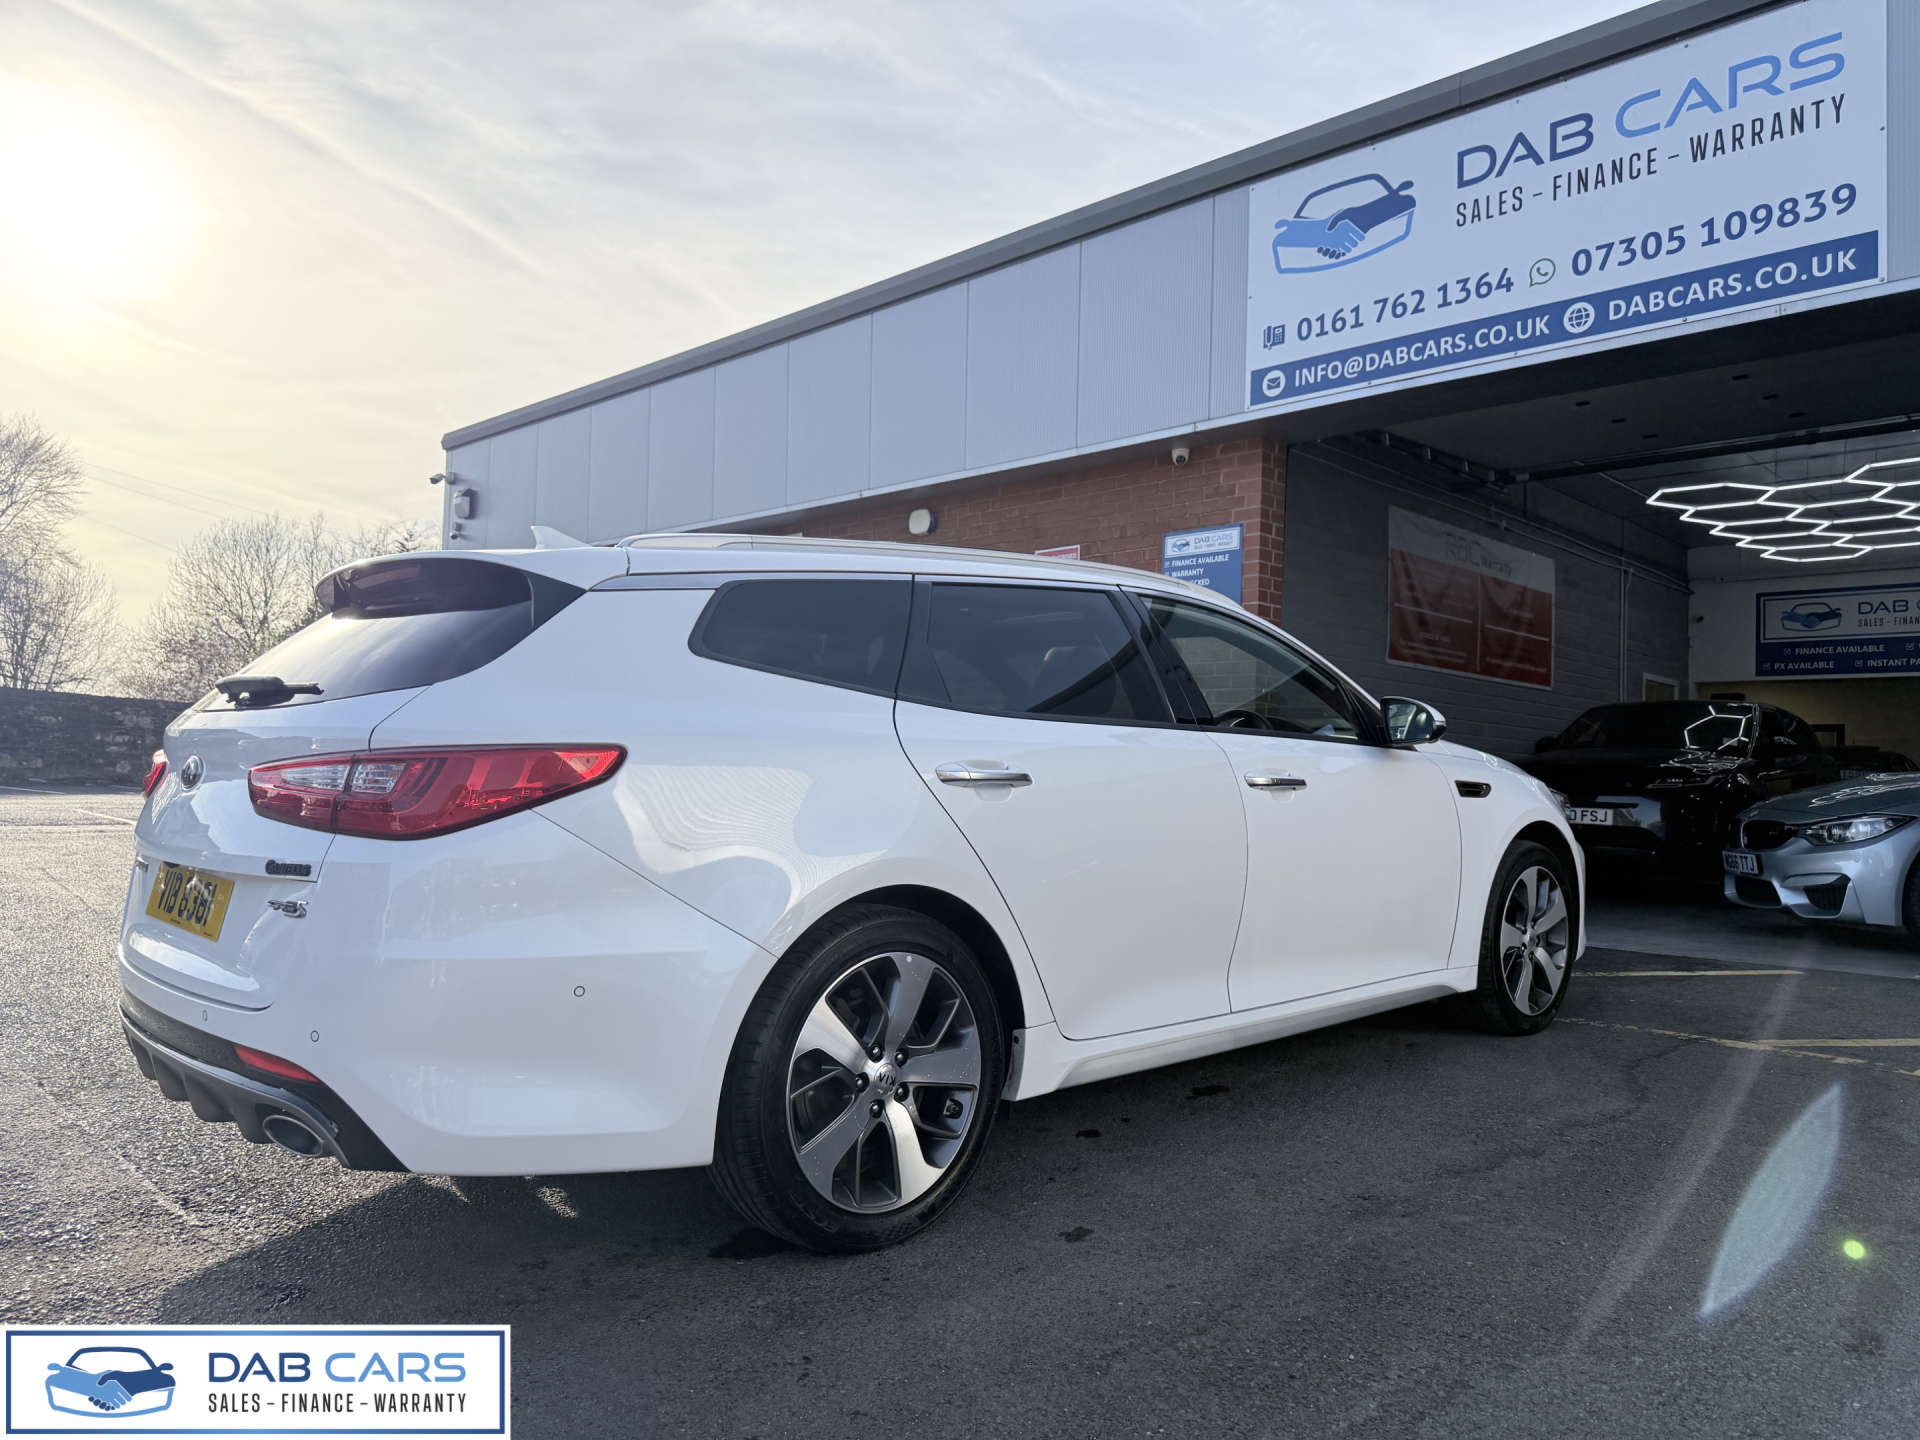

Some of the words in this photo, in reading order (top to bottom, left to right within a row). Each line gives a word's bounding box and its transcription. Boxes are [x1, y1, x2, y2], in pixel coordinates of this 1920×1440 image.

[1456, 112, 1594, 190] DAB
[1615, 31, 1846, 139] CARS
[1456, 186, 1524, 227] SALES
[1552, 147, 1658, 201] FINANCE
[1689, 93, 1846, 163] WARRANTY
[1571, 224, 1687, 277] 07305
[1700, 183, 1857, 247] 109839
[1608, 248, 1857, 321] DABCARS.CO.UK
[1296, 304, 1364, 342] 0161
[1373, 289, 1426, 323] 762
[1436, 267, 1515, 309] 1364
[1294, 314, 1551, 388] INFO@DABCARS.CO.UK
[1172, 558, 1196, 567] FINANCE
[1198, 554, 1229, 563] AVAILABLE
[1172, 568, 1204, 577] WARRANTY
[1858, 599, 1909, 615] DAB
[1857, 617, 1884, 628] SALES
[1795, 646, 1834, 655] FINANCE
[1836, 644, 1885, 654] AVAILABLE
[1787, 660, 1835, 670] AVAILABLE
[1867, 659, 1907, 668] INSTANT
[1581, 809, 1608, 823] FSJ
